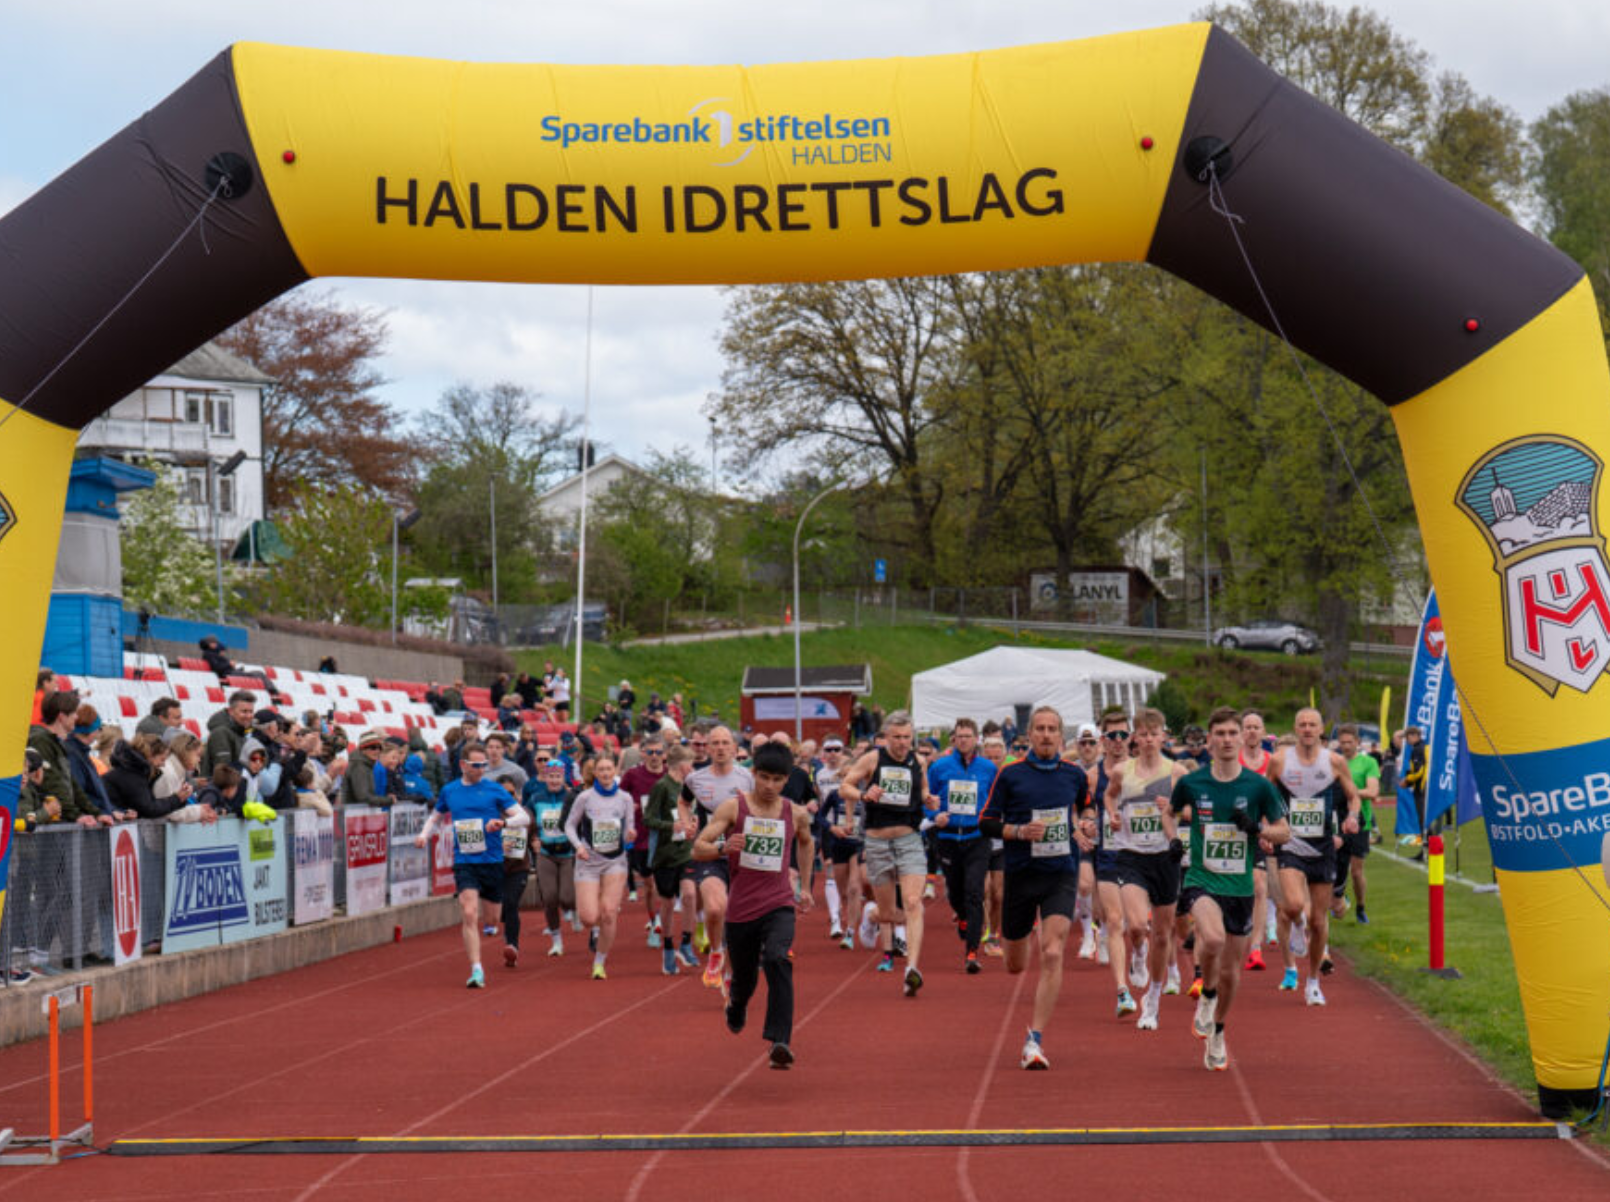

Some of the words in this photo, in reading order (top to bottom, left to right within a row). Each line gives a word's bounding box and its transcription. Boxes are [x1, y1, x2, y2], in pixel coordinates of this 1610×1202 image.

[541, 116, 711, 148] Sparebank
[739, 114, 889, 141] stiftelsen
[792, 143, 892, 166] HALDEN
[376, 176, 637, 233] HALDEN
[664, 167, 1065, 233] IDRETTSLAG
[1131, 818, 1162, 832] 707
[1293, 812, 1321, 825] 760
[747, 836, 780, 855] 732
[1208, 841, 1243, 858] 715
[196, 862, 242, 909] BODEN
